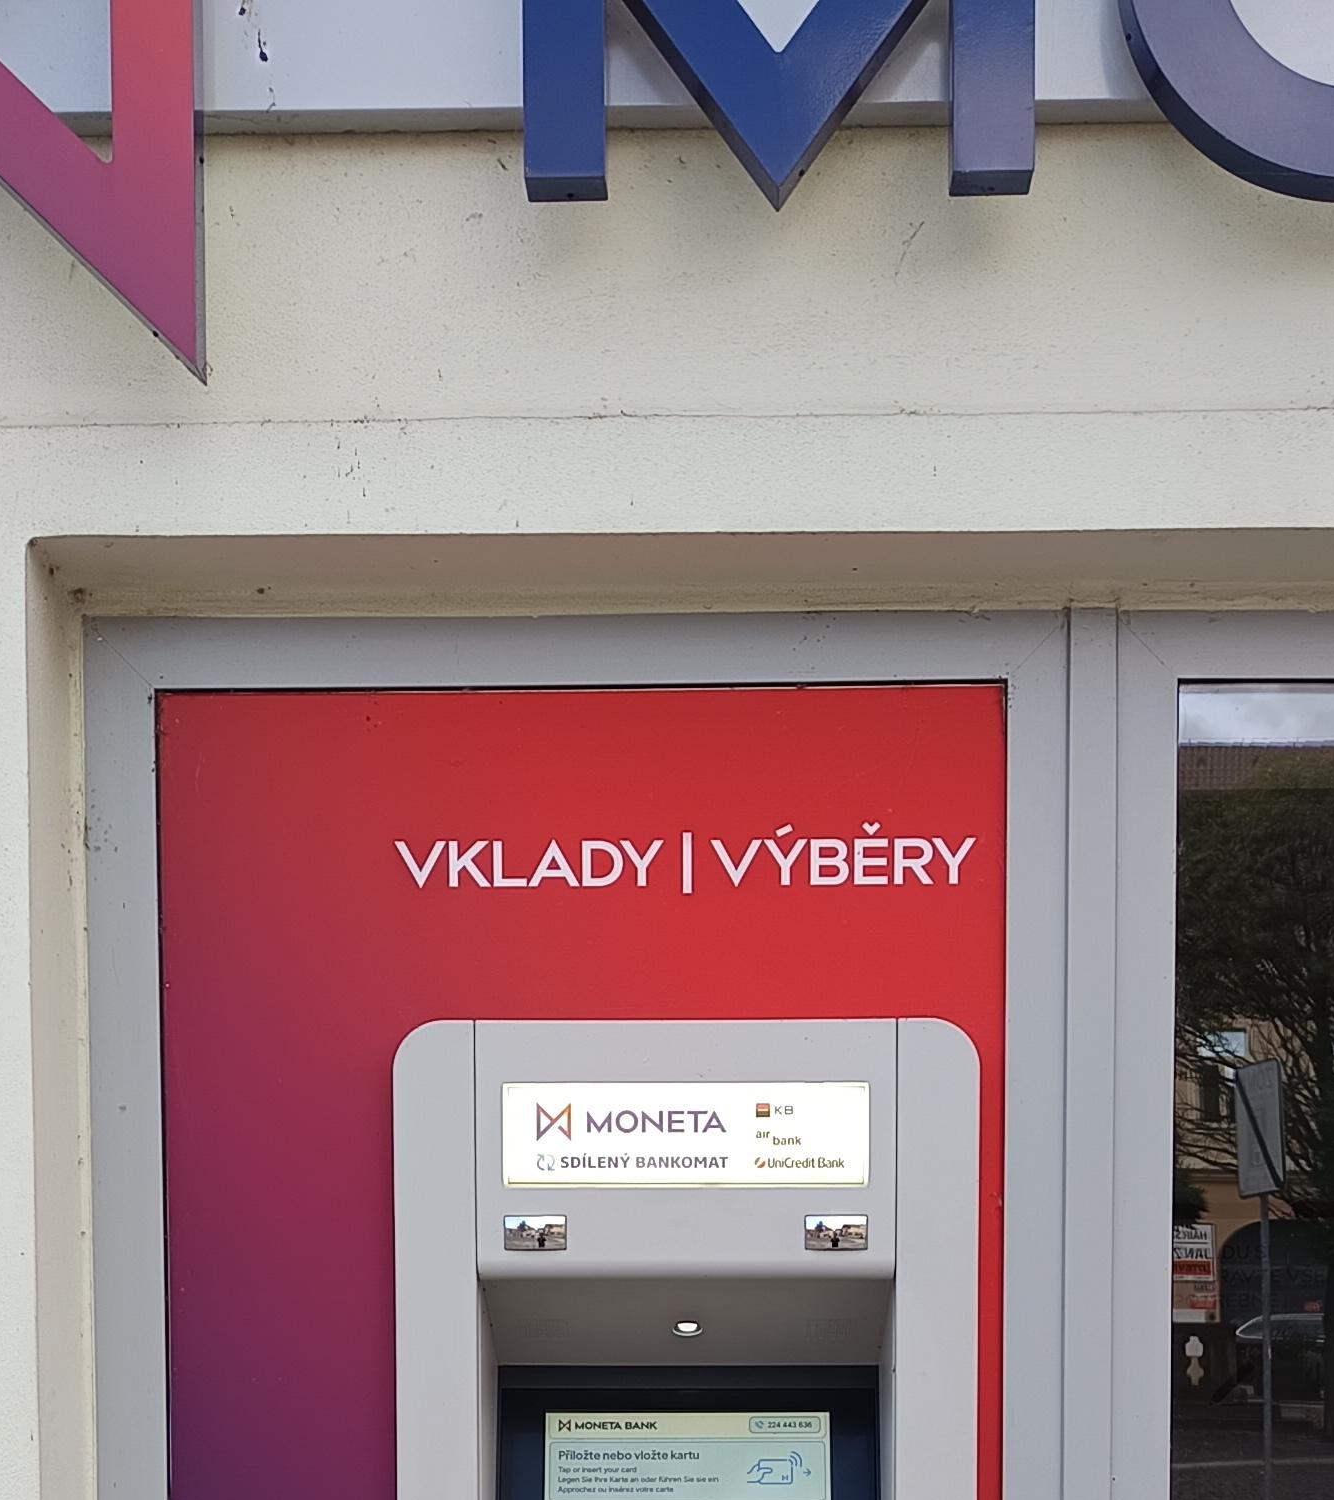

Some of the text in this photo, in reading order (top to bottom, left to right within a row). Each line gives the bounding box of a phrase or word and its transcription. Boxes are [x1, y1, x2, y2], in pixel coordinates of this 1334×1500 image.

[393, 837, 665, 890] VKLADY
[709, 821, 978, 888] VÝBĚRY
[774, 1105, 794, 1116] KB
[585, 1108, 728, 1135] MONETA
[755, 1130, 802, 1146] air bank
[560, 1152, 729, 1169] SDÍLENÝ BANKOMAT
[767, 1156, 845, 1169] UniCredit Bank
[574, 1421, 658, 1430] MONETA BANK
[558, 1449, 700, 1461] Přiložte nebo vložte kartu
